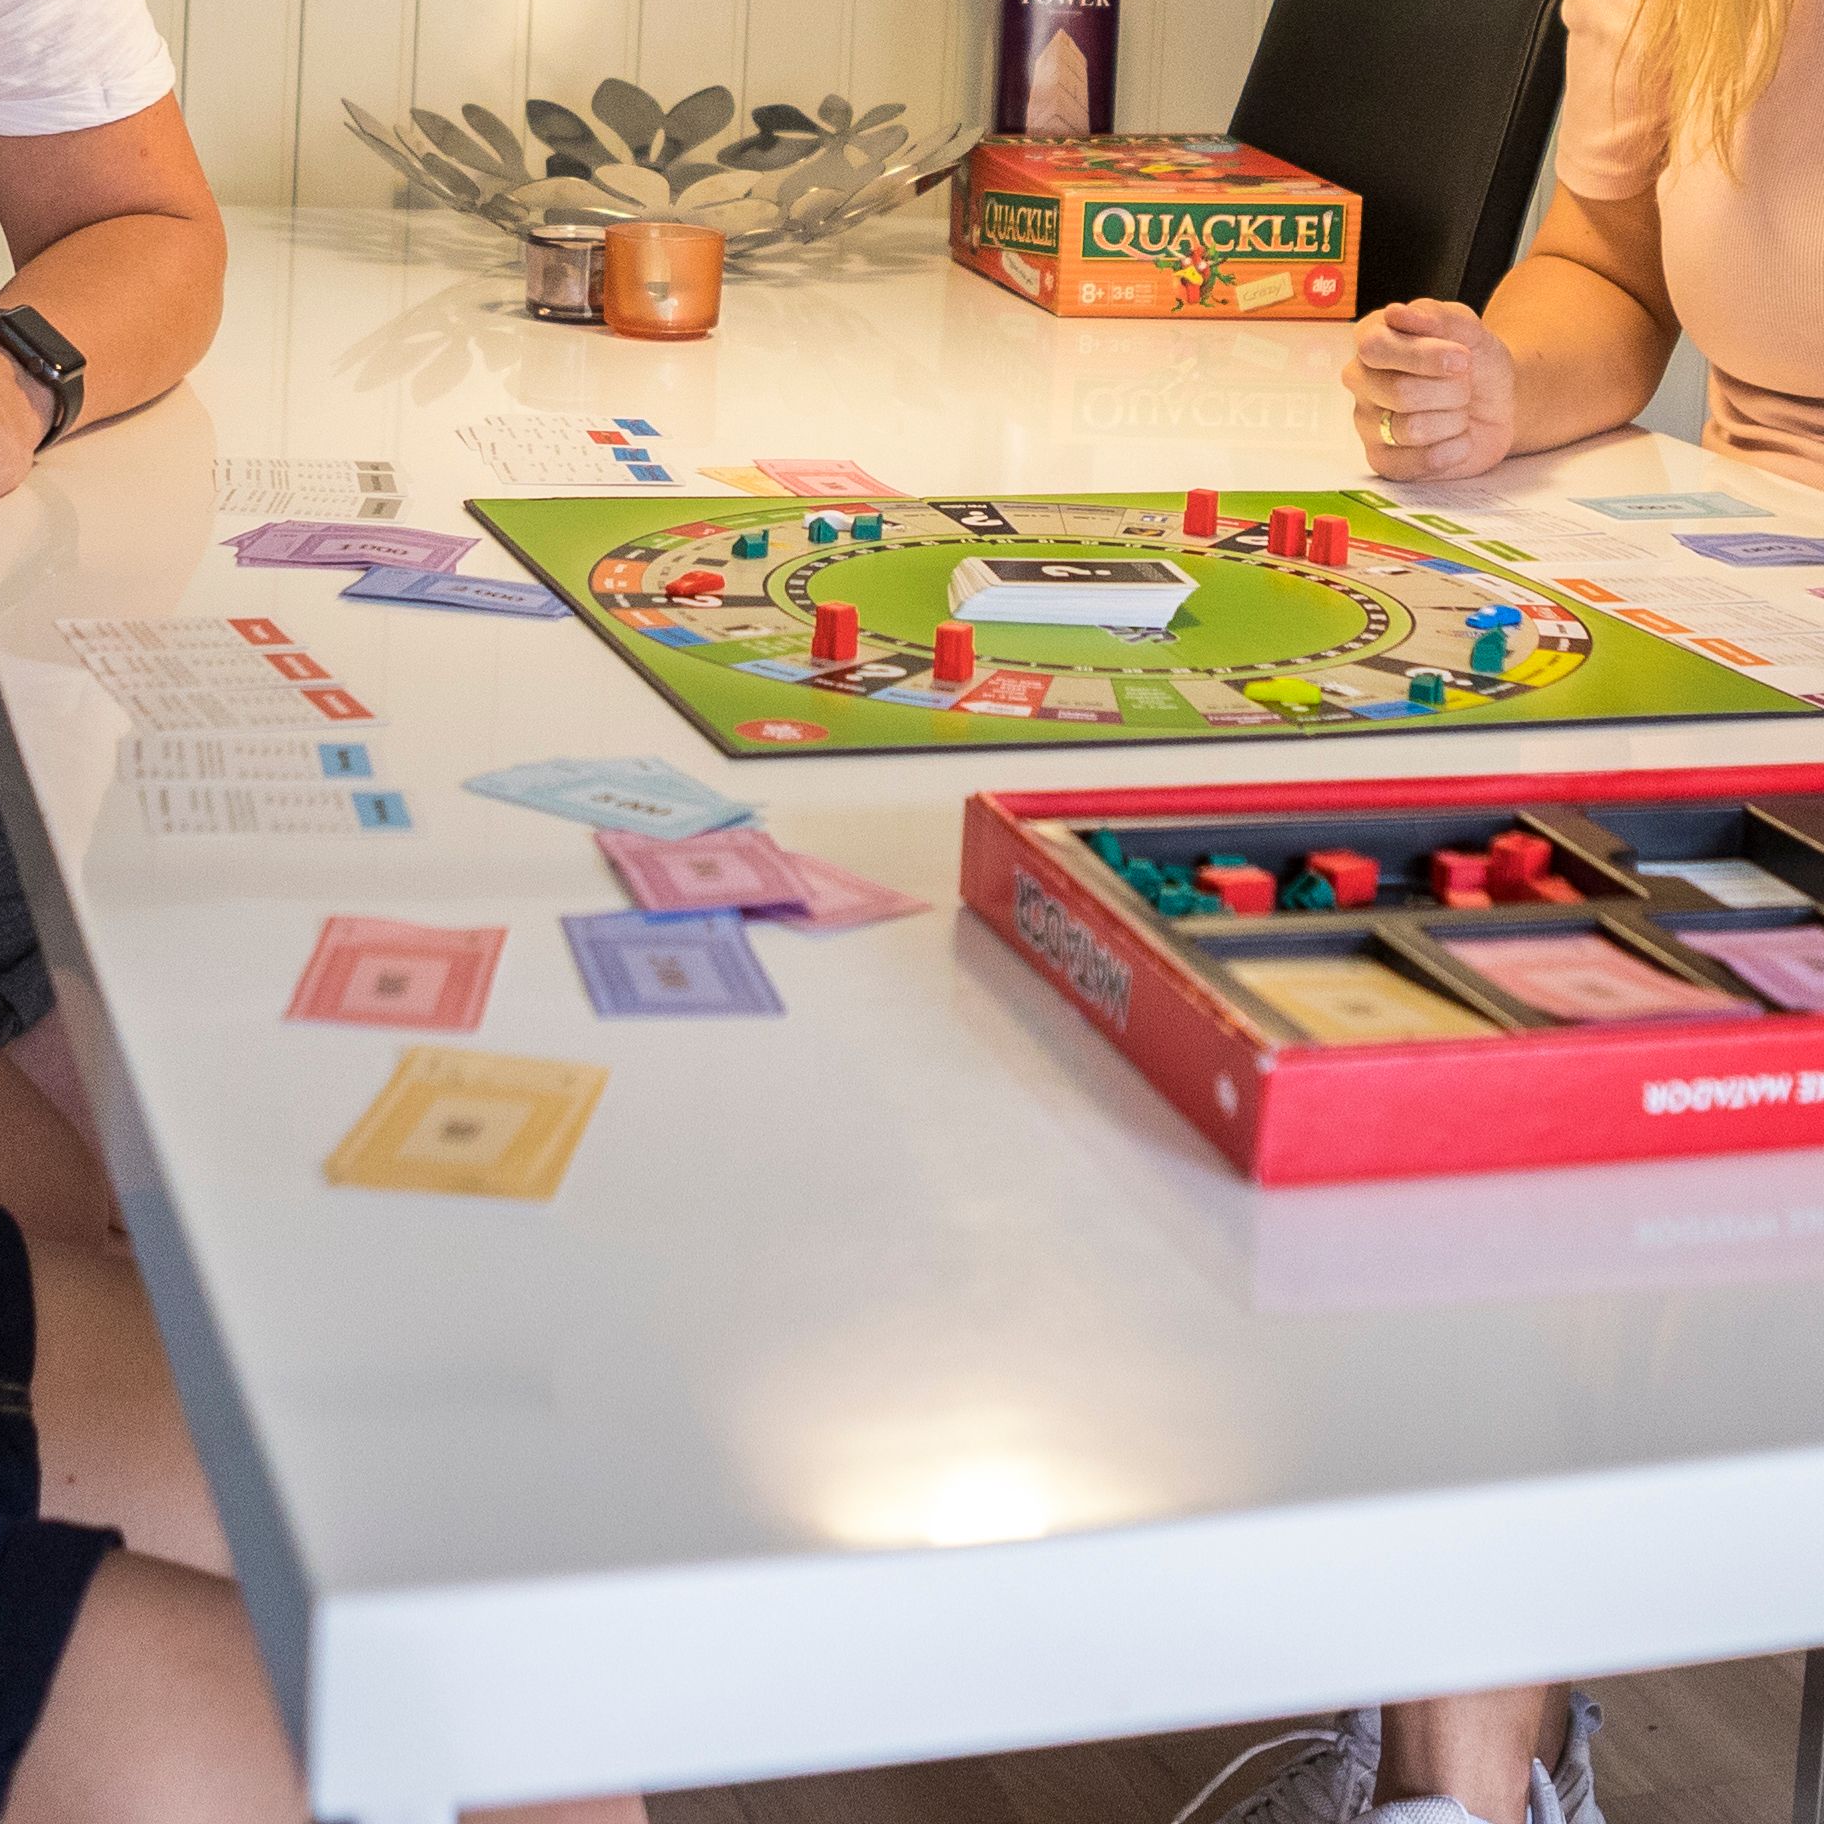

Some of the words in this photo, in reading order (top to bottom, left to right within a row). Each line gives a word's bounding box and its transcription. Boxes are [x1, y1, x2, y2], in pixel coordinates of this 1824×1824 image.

[985, 197, 1057, 247] QUACKLE!
[1093, 207, 1333, 260] QUACKLE!
[1081, 283, 1105, 304] 8+
[1312, 275, 1337, 296] alga
[1643, 1075, 1791, 1115] MATADOR
